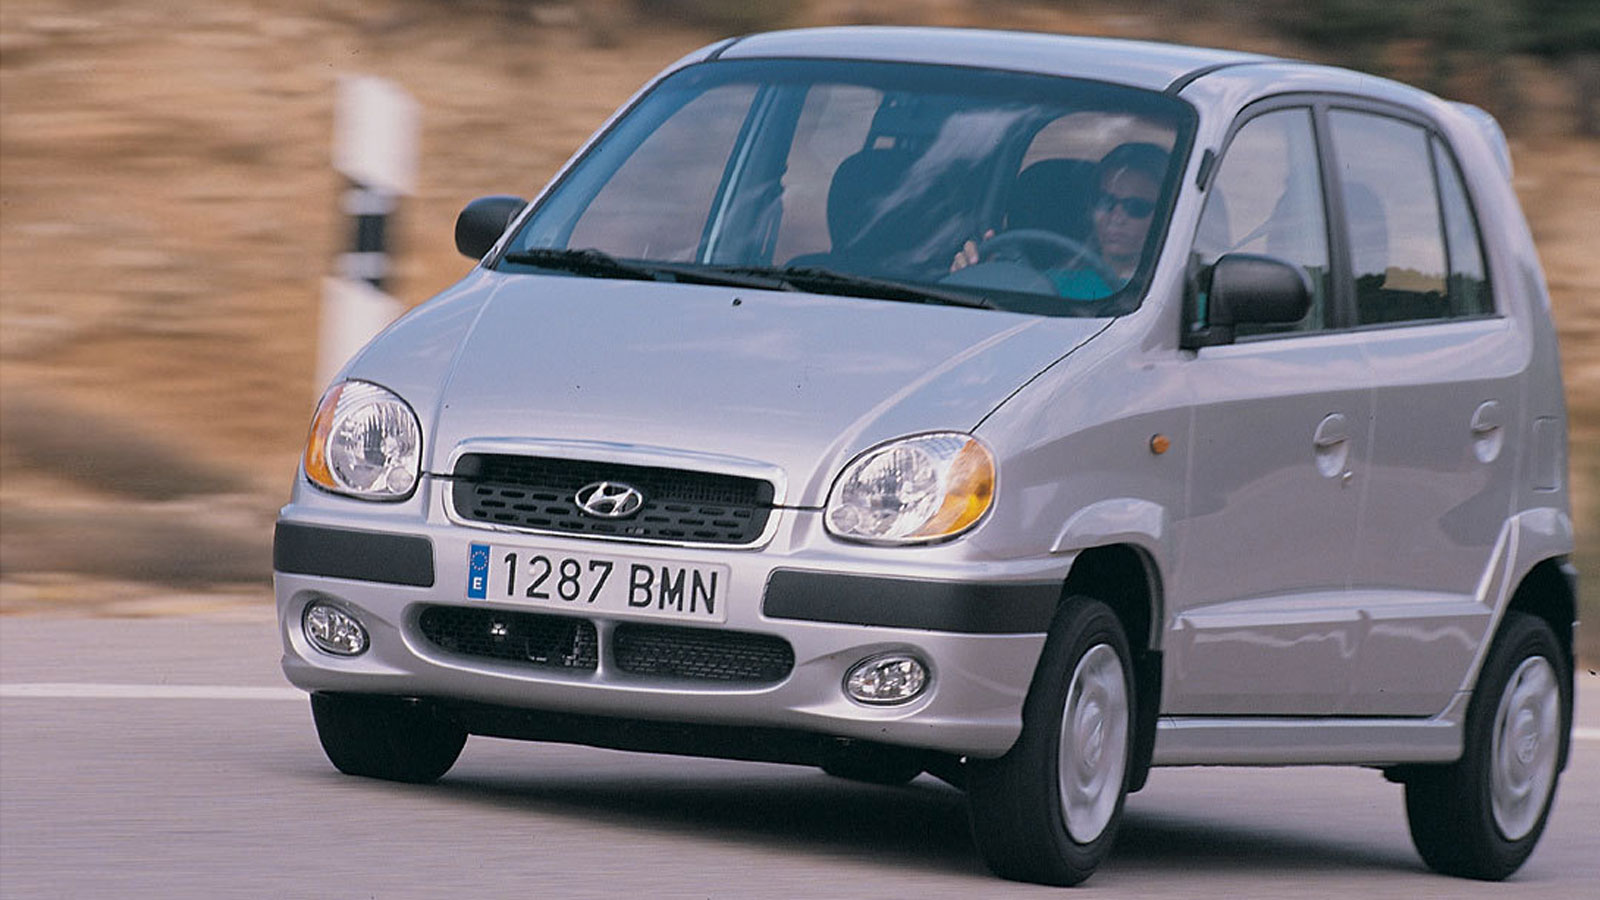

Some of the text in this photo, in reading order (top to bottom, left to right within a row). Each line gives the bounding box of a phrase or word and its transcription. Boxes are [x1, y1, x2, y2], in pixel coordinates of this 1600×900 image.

[472, 577, 482, 590] E
[504, 552, 718, 614] 1287 BMN
